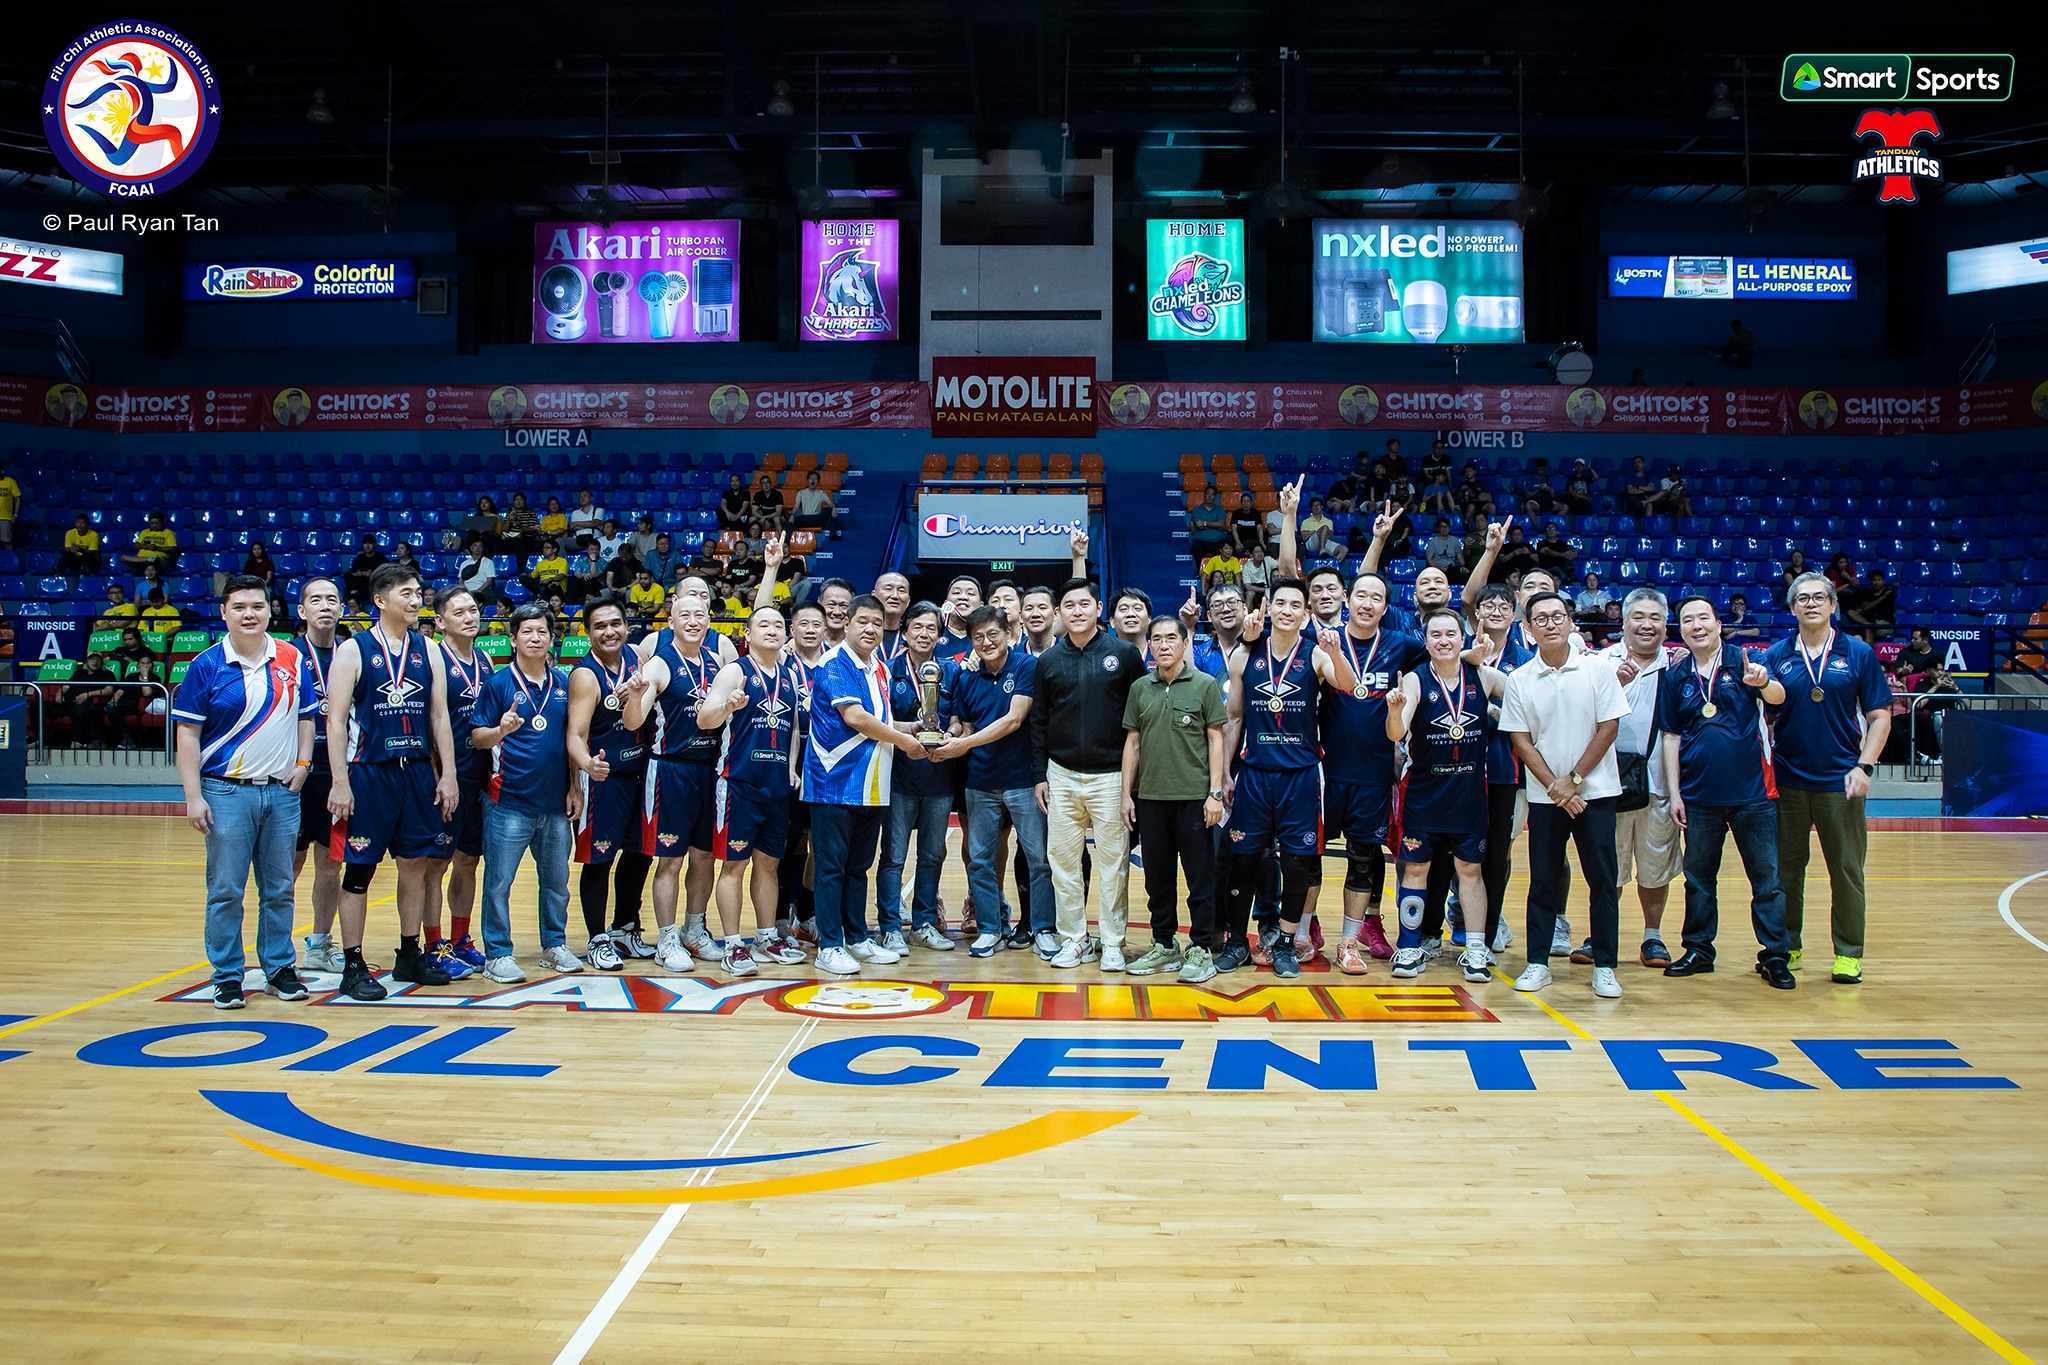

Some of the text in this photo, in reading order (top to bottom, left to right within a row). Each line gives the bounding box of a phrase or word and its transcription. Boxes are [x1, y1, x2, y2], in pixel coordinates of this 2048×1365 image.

[823, 223, 876, 237] HOME
[1168, 222, 1226, 237] HOME
[544, 226, 662, 260] Akari
[667, 236, 725, 245] TURBO FAN
[1322, 225, 1446, 258] nxled
[1447, 235, 1504, 244] NO POWER?
[0, 242, 62, 258] PETRO
[667, 247, 727, 256] AIR COOLER
[1447, 244, 1519, 253] NO PROBLEM!
[208, 266, 245, 293] Rain
[245, 269, 298, 290] Shine
[314, 264, 395, 283] Colorful
[1737, 264, 1760, 279] EL
[1765, 264, 1853, 281] HENERAL
[314, 282, 394, 294] PROTECTION
[1162, 277, 1209, 298] nxled
[1737, 283, 1852, 293] ALL-PURPOSE EPOXY
[1153, 286, 1241, 312] CHAMELEONS
[823, 302, 875, 317] Akari
[813, 316, 884, 330] CHARGERS
[755, 390, 854, 409] CHITOK'S
[935, 375, 1092, 409] MOTOLITE
[95, 394, 190, 415] CHITOK'S
[317, 393, 411, 412] CHITOK'S
[533, 391, 630, 411] CHITOK'S
[1157, 391, 1257, 410] CHITOK'S
[1385, 392, 1484, 412] CHITOK'S
[1612, 395, 1710, 414] CHITOK'S
[1844, 396, 1941, 416] CHITOK'S
[316, 412, 349, 420] CHIBOG
[350, 412, 362, 420] NA
[380, 412, 392, 420] NA
[533, 411, 566, 419] CHIBOG
[567, 411, 579, 419] NA
[598, 411, 610, 419] NA
[755, 410, 789, 418] CHIBOG
[790, 410, 803, 418] NA
[822, 410, 835, 418] NA
[936, 412, 1092, 422] PANGMATAGALAN
[1157, 410, 1192, 418] CHIBOG
[1193, 410, 1206, 418] NA
[1225, 410, 1238, 418] NA
[1386, 411, 1420, 421] CHIBOG
[1421, 411, 1434, 421] NA
[1453, 411, 1466, 421] NA
[1613, 414, 1646, 423] CHIBOG
[1648, 414, 1661, 423] NA
[1679, 414, 1692, 423] NA
[1845, 416, 1878, 424] CHIBOG
[505, 428, 589, 447] LOWER A
[1511, 431, 1525, 448] B
[992, 562, 1013, 570] EXIT
[27, 621, 76, 631] RINGSIDE
[91, 634, 120, 643] nxled
[176, 634, 205, 642] nxled
[477, 639, 506, 647] nxled
[39, 632, 63, 660] A
[1943, 641, 1968, 671] A
[629, 748, 643, 756] Smart
[1452, 745, 1459, 762] 4
[943, 980, 1502, 1023] TIME
[76, 1020, 562, 1078] OIL
[787, 1034, 2022, 1092] CENTRE
